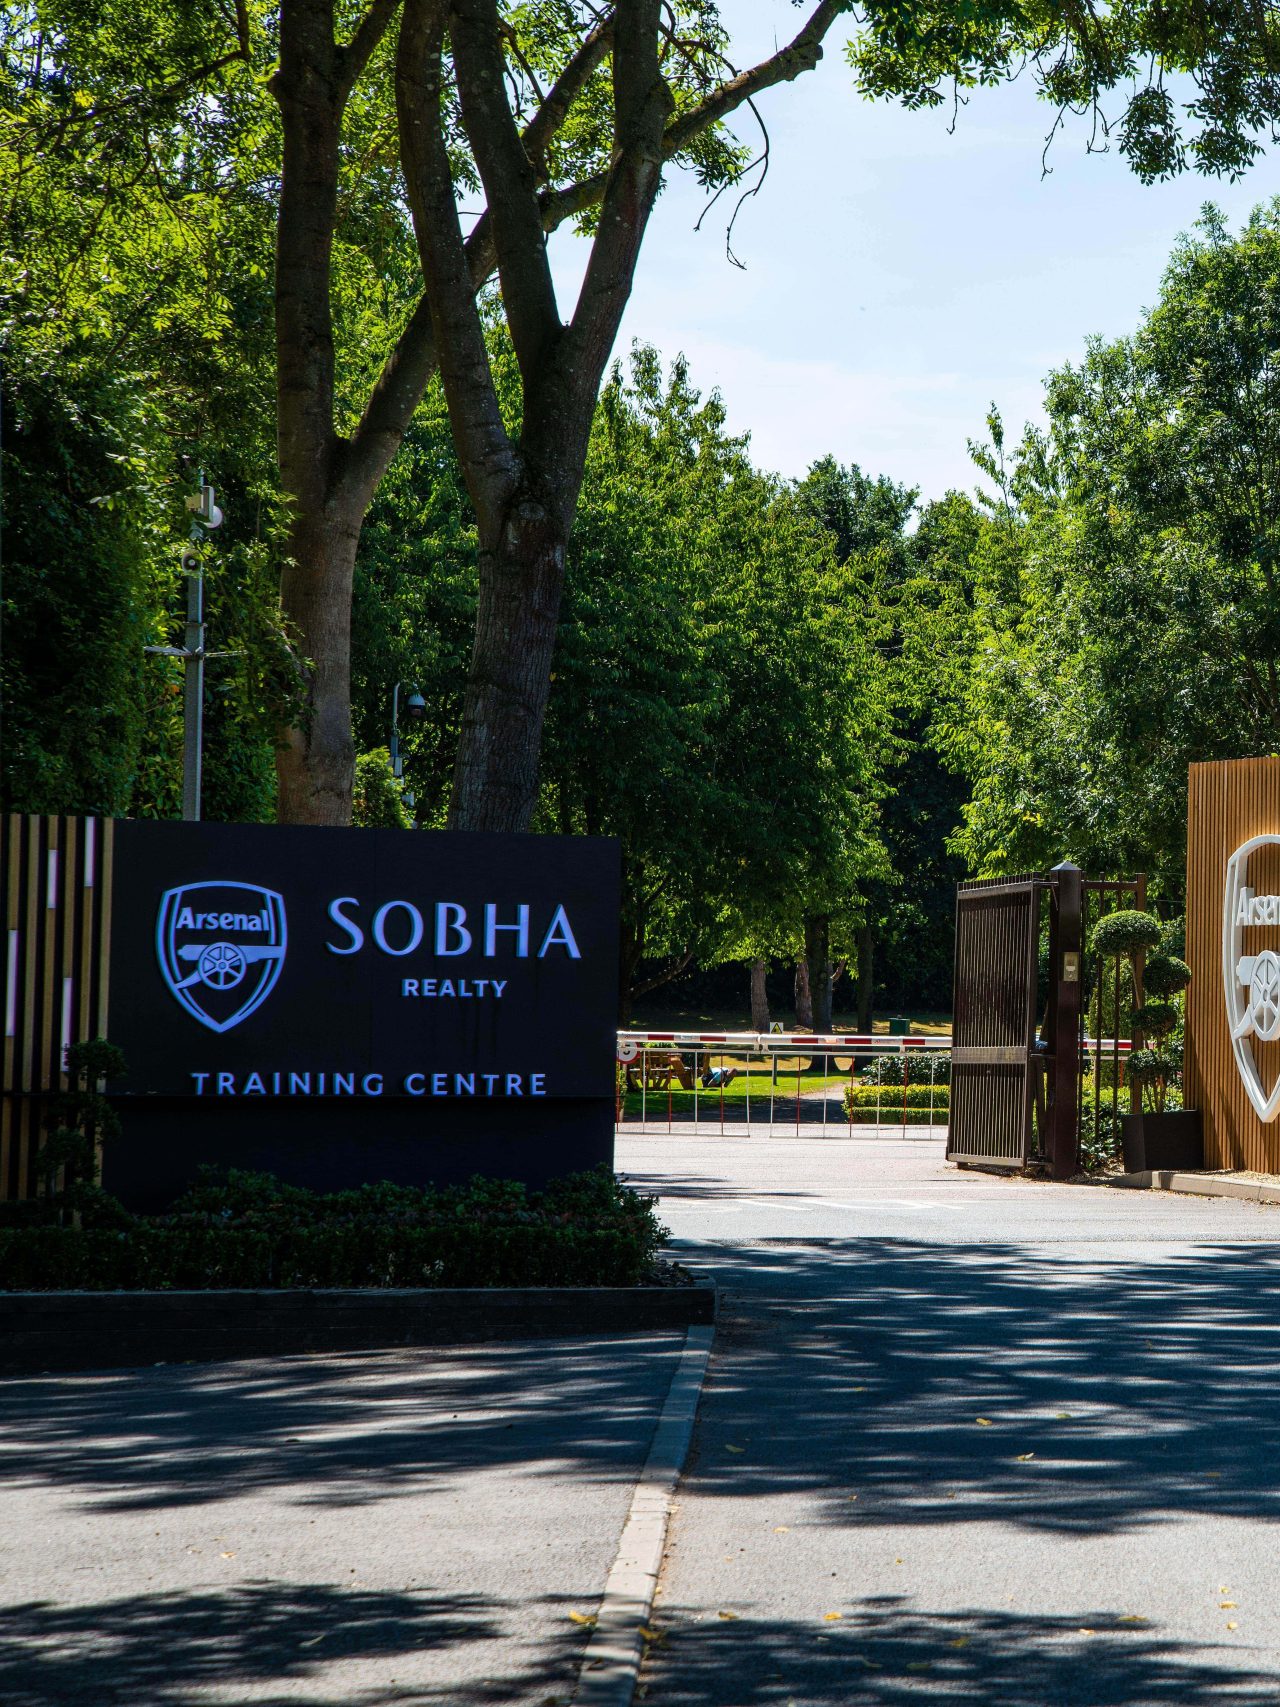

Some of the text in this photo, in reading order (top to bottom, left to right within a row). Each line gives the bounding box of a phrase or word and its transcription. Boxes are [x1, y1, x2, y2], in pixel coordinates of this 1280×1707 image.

[176, 907, 270, 931] Arsenal
[326, 897, 582, 960] SOBHA
[402, 979, 508, 998] REALTY
[192, 1072, 547, 1095] TRAINING CENTRE
